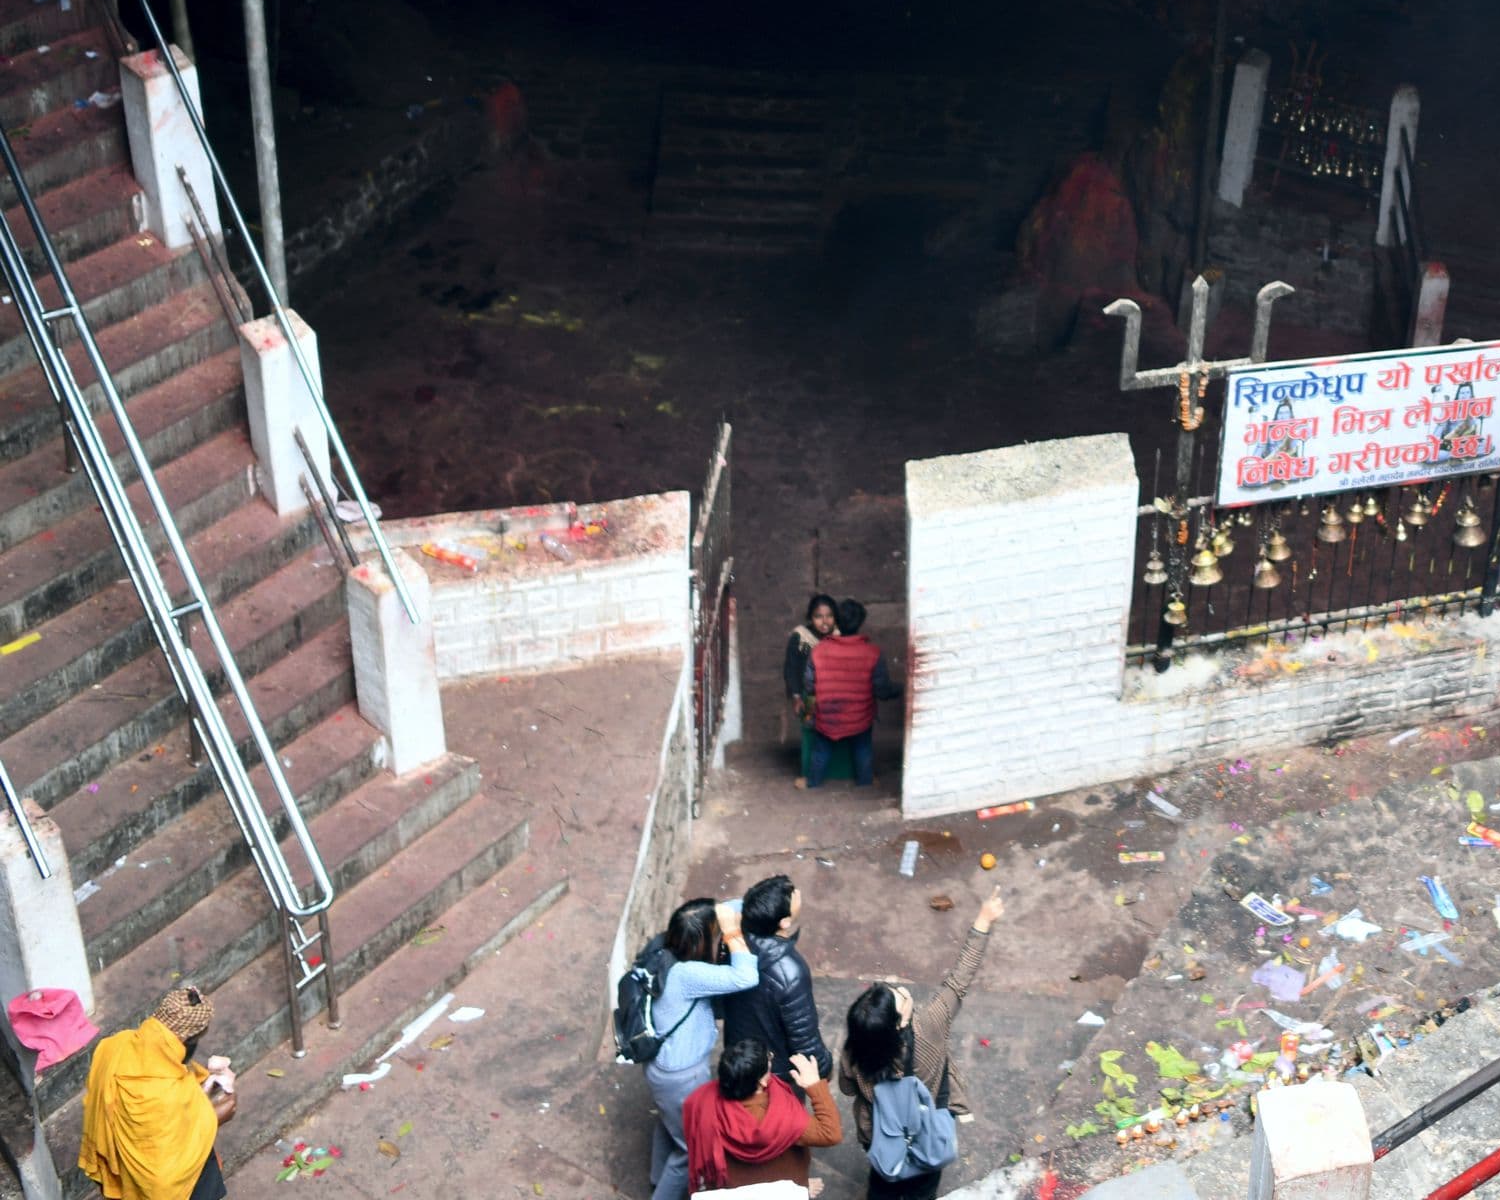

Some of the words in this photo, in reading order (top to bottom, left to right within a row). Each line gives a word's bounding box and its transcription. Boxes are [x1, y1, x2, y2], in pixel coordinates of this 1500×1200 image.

[1377, 361, 1412, 389] यो
[1244, 416, 1320, 446] भन्दा
[1332, 406, 1392, 434] भित्र
[1403, 396, 1495, 427] लैजान
[1237, 451, 1317, 487] निषेध
[1329, 434, 1441, 473] गरीएको
